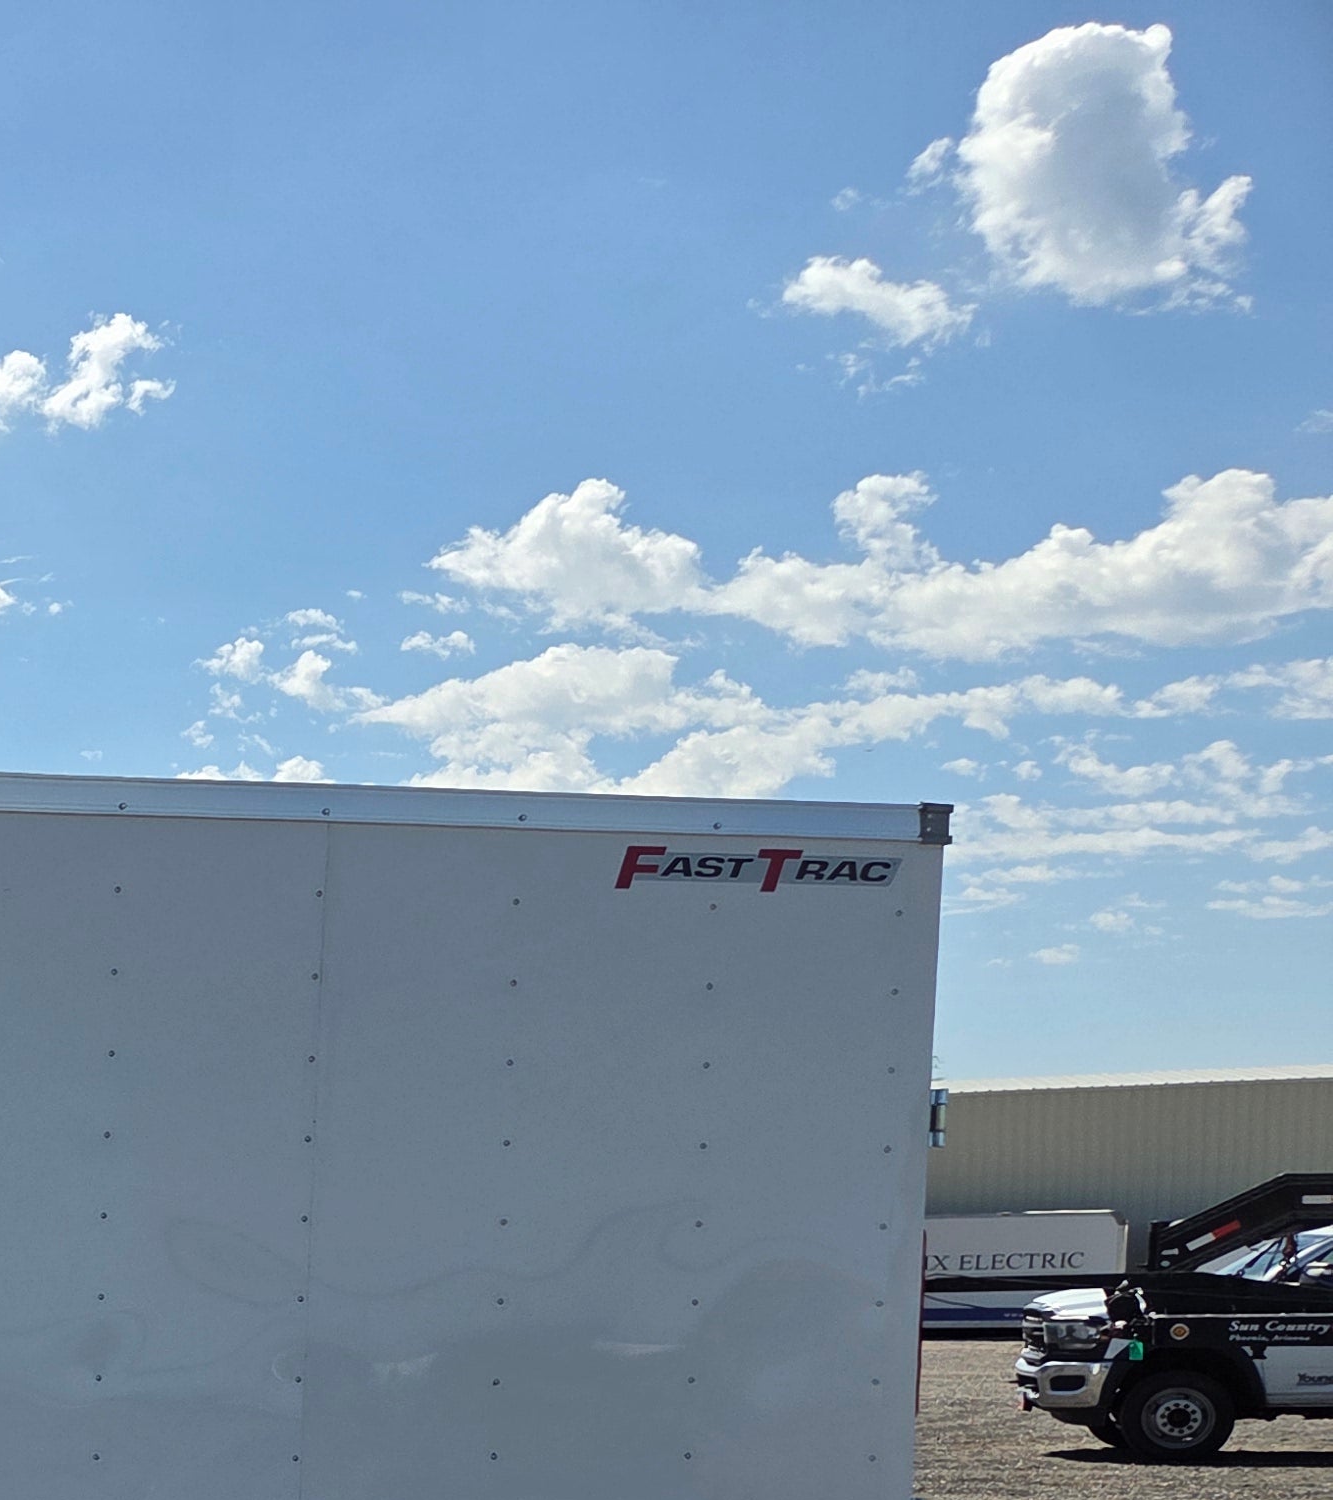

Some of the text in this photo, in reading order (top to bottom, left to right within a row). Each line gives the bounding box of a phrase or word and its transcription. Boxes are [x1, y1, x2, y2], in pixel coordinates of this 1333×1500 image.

[757, 848, 892, 893] TRAC
[959, 1252, 1085, 1271] ELECTRIC
[1229, 1320, 1331, 1335] Sun Country
